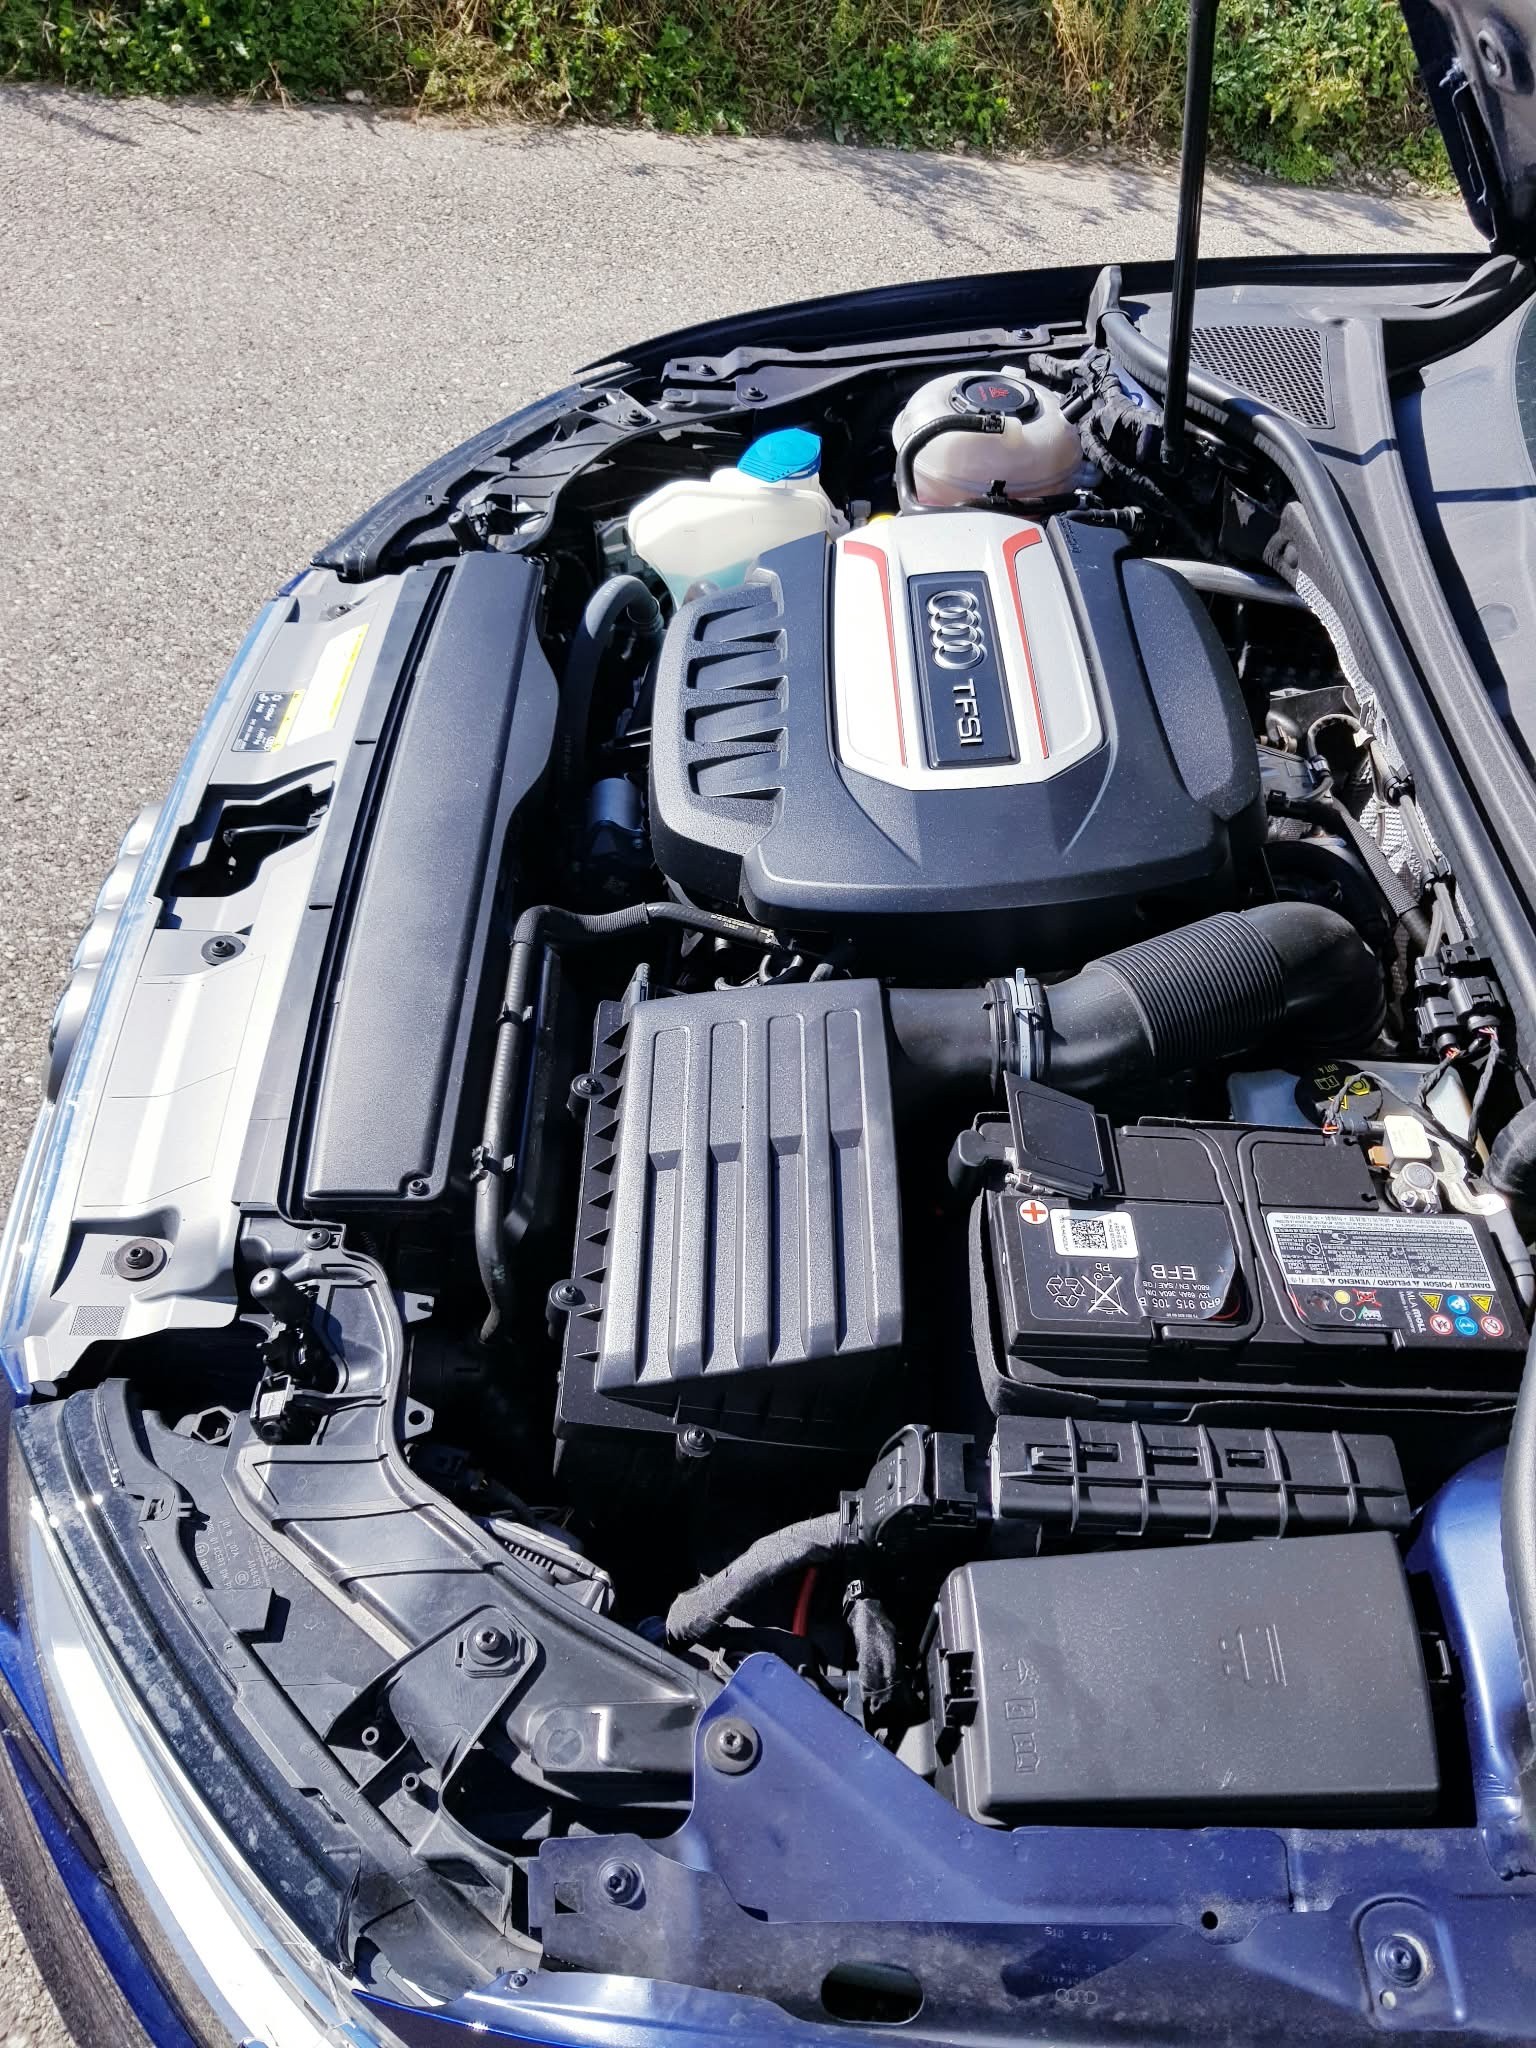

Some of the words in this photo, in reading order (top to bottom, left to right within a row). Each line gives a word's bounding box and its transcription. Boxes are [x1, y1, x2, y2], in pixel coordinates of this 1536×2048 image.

[952, 678, 983, 746] TFSI
[1095, 1262, 1110, 1272] Pb
[1151, 1264, 1196, 1280] EFB
[1378, 1278, 1411, 1287] PELIGRO
[1463, 1281, 1491, 1289] DANGER
[1138, 1297, 1148, 1306] B
[1152, 1298, 1170, 1308] 105
[1176, 1299, 1195, 1309] 915
